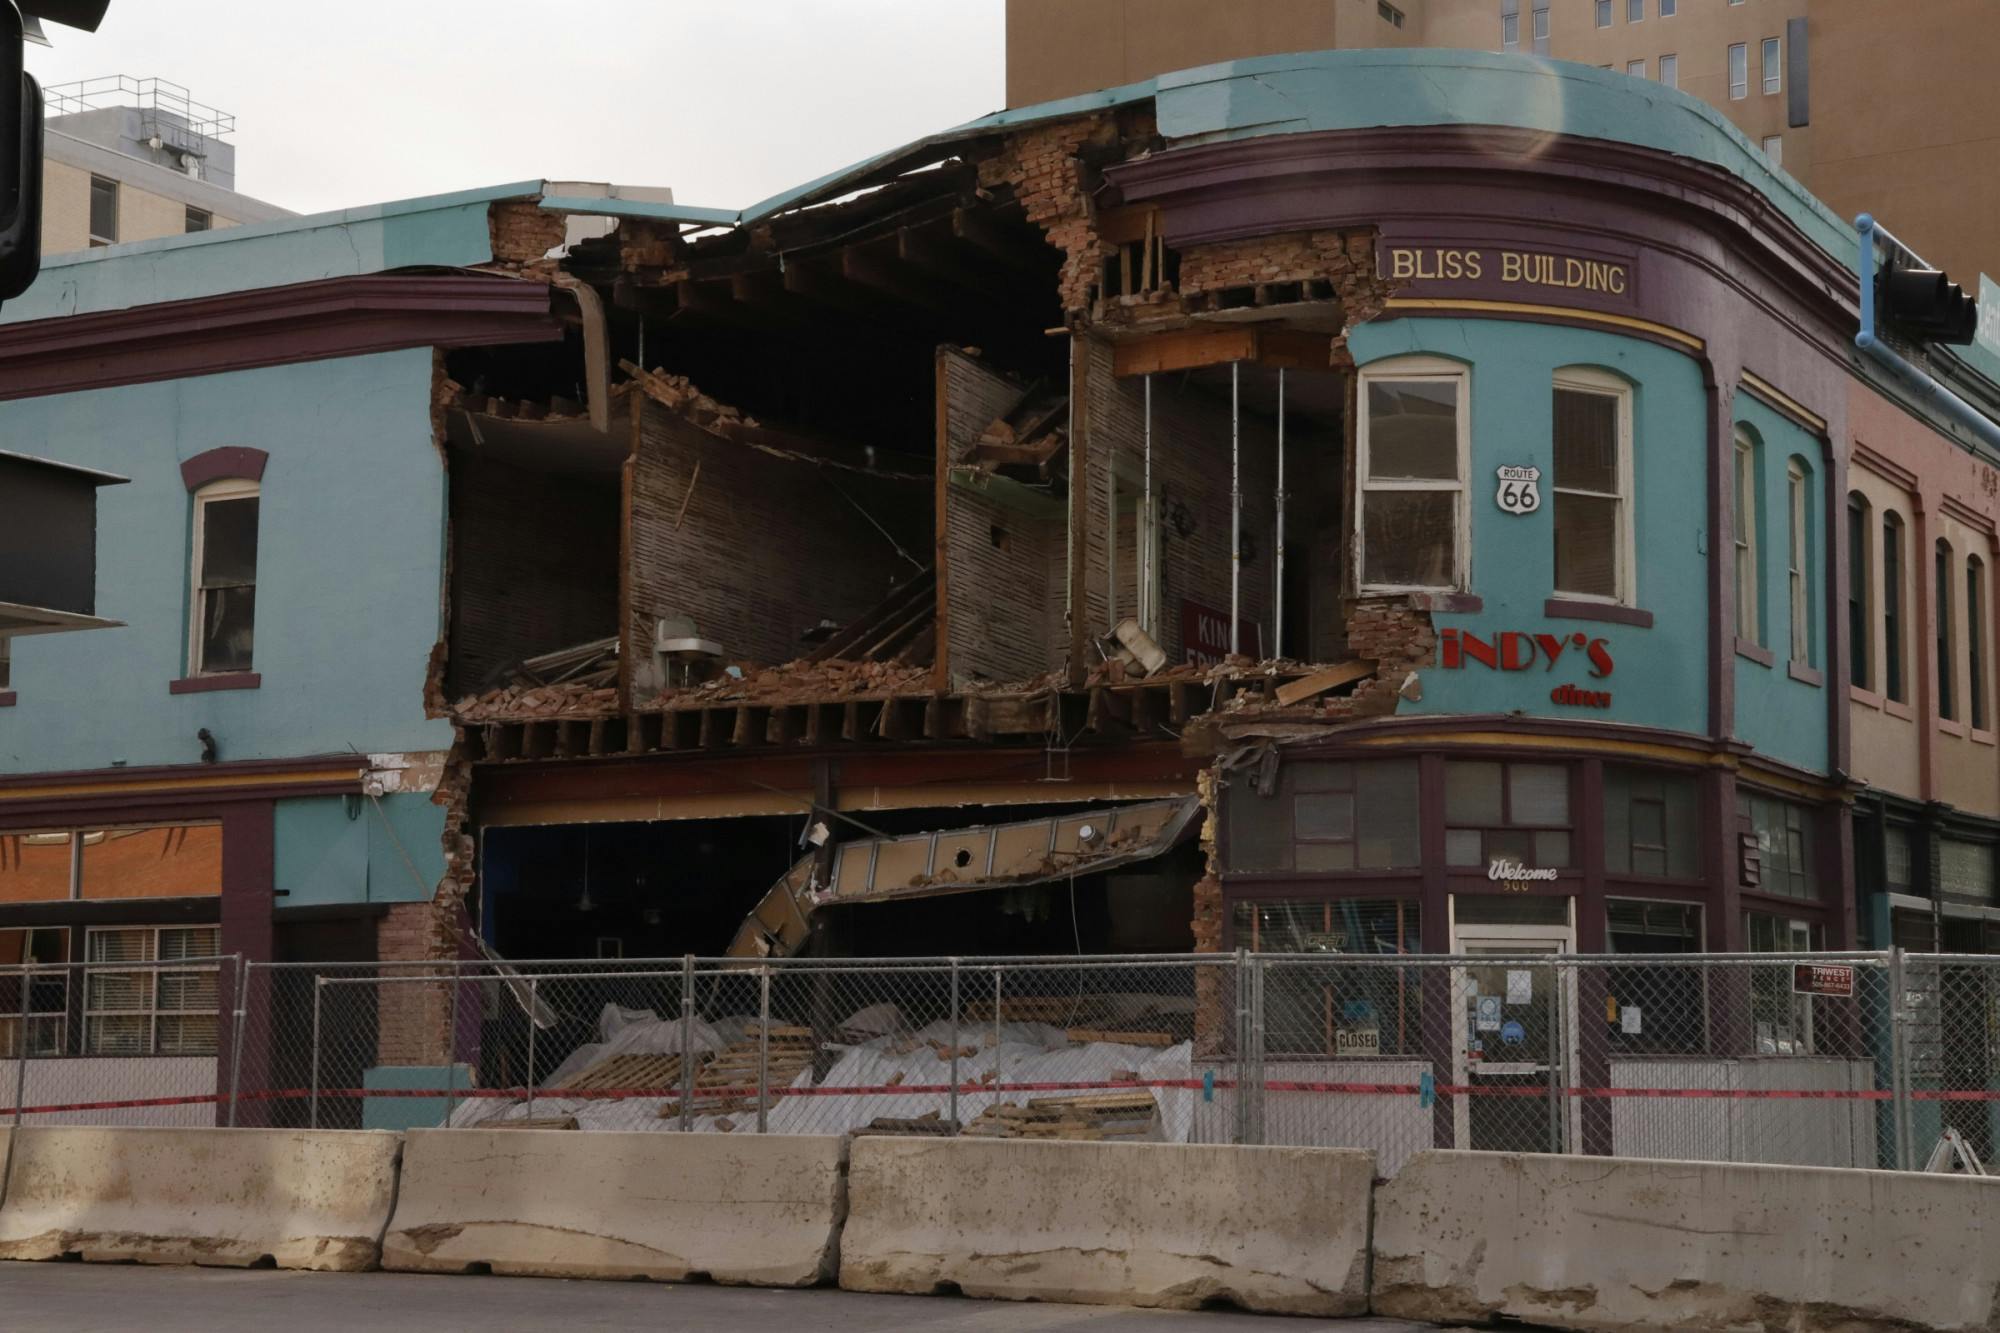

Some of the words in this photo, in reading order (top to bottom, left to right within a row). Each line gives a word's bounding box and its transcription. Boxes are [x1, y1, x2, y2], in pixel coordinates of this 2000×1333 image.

[1392, 249, 1482, 279] BLISS
[1501, 252, 1625, 294] BUILDING
[1503, 468, 1533, 479] ROUTE
[1503, 482, 1535, 508] 66
[1551, 684, 1612, 708] diner
[1488, 859, 1558, 880] Welcome
[1811, 967, 1850, 977] TRIWEST
[1339, 1033, 1378, 1048] CLOSED
